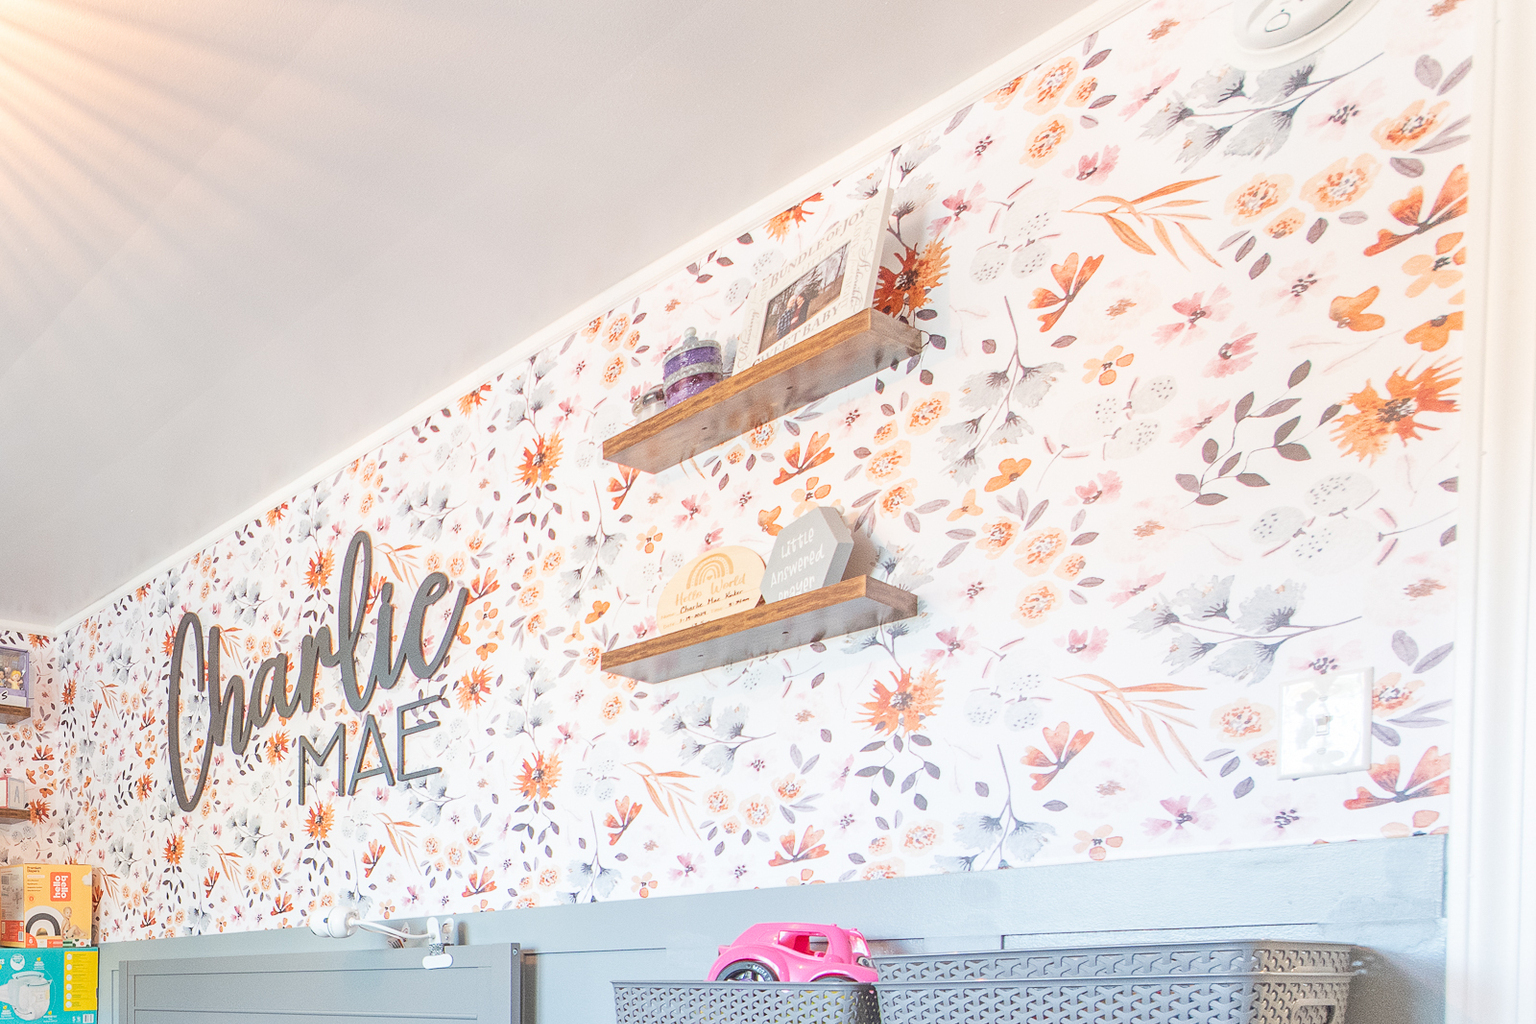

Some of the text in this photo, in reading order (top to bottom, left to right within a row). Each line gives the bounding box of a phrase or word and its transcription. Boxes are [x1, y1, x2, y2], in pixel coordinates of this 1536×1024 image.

[770, 239, 824, 289] BUNDLE
[840, 204, 869, 241] JOY
[803, 307, 839, 335] BABY
[770, 543, 825, 588] Answered
[675, 572, 746, 606] Hello World
[167, 530, 470, 813] Charlie
[298, 694, 443, 806] MAE
[53, 876, 61, 898] hello
